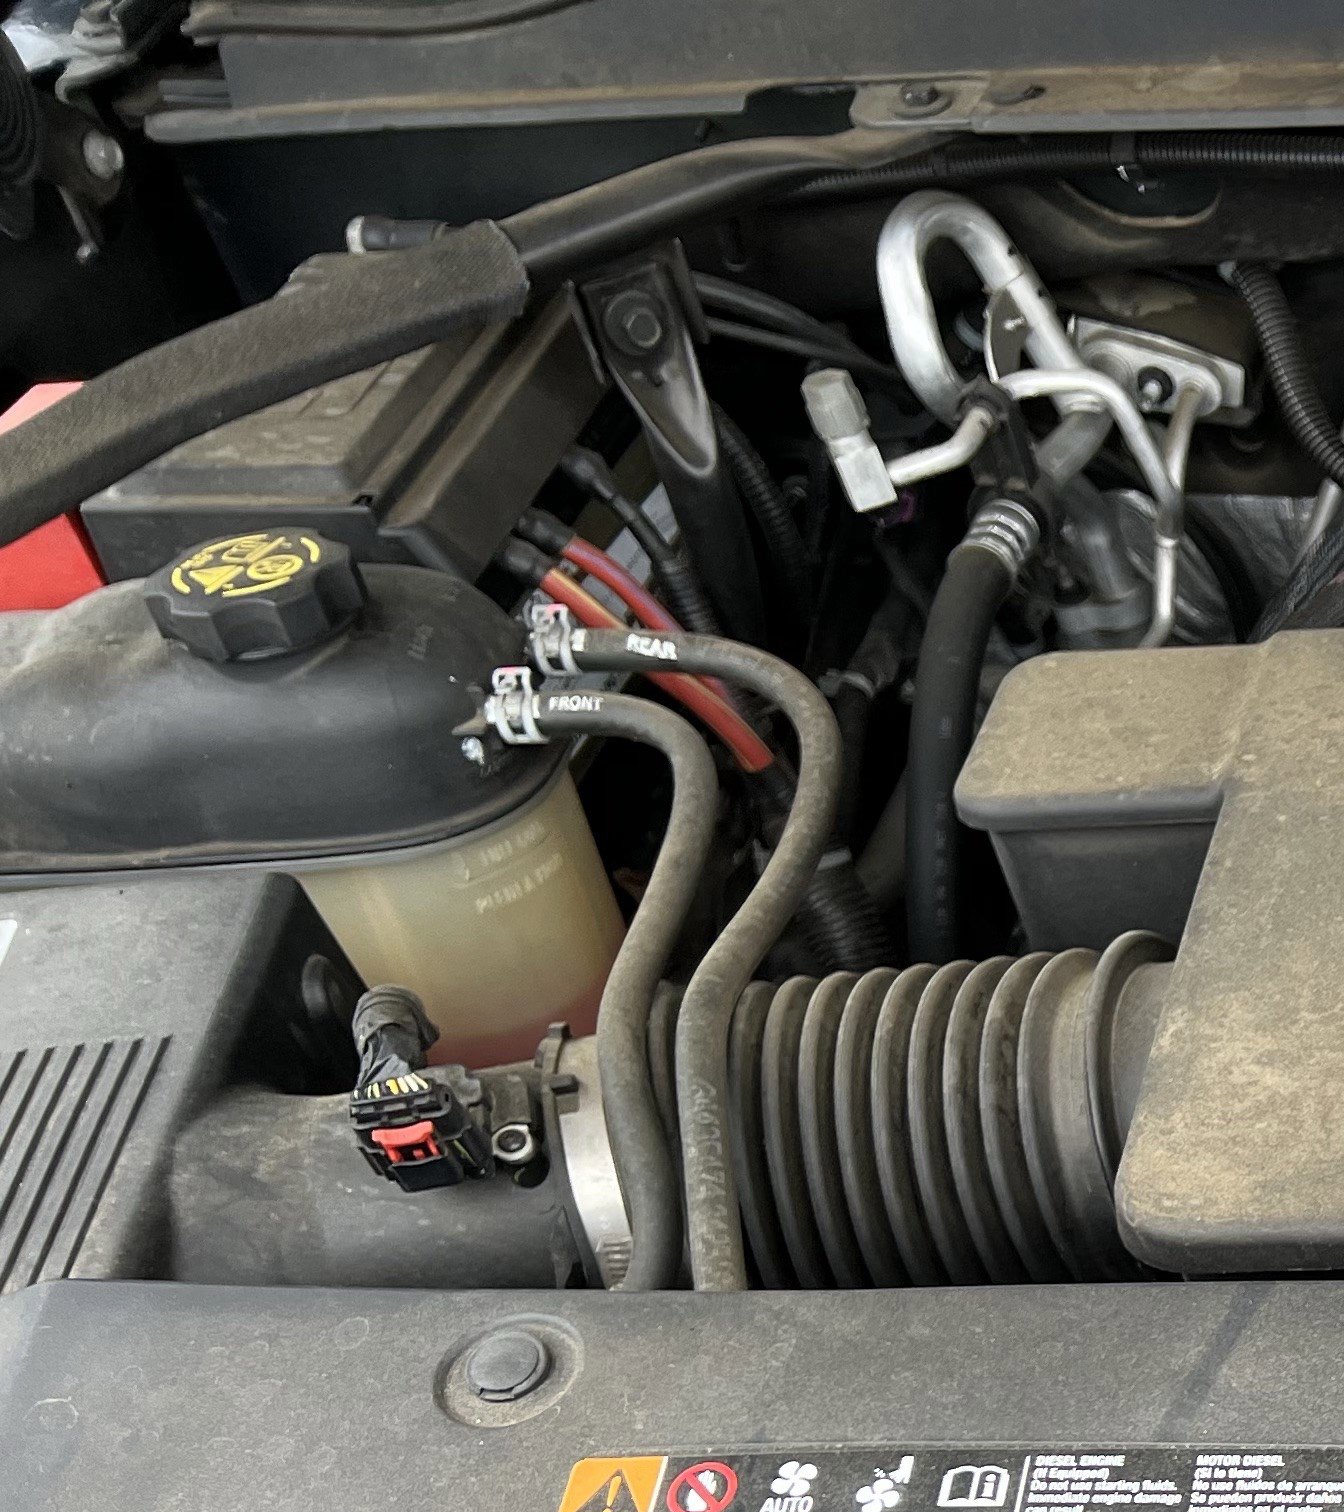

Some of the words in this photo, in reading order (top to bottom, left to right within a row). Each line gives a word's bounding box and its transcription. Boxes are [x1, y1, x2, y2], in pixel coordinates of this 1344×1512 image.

[627, 633, 678, 660] REAR
[549, 695, 604, 712] FRONT
[1035, 1455, 1077, 1466] DIESEL
[1080, 1455, 1126, 1466] ENGINE
[1196, 1454, 1241, 1466] MOTOR
[1242, 1455, 1285, 1466] DIESEL
[1049, 1467, 1110, 1481] Equipped)
[1030, 1480, 1047, 1491] Do
[1048, 1480, 1069, 1491] not
[1070, 1482, 1093, 1491] use
[1094, 1480, 1141, 1493] starting
[1142, 1480, 1177, 1491] fluids.
[1192, 1480, 1210, 1491] No
[1211, 1482, 1234, 1491] use
[1235, 1479, 1275, 1491] fluidos
[1276, 1480, 1293, 1491] de
[1027, 1492, 1090, 1503] Immediate
[1091, 1492, 1132, 1505] engine
[1133, 1492, 1182, 1505] damage
[1190, 1492, 1206, 1503] Se
[1207, 1492, 1253, 1505] pueden
[1254, 1492, 1305, 1505] producir
[1306, 1491, 1342, 1503] daños
